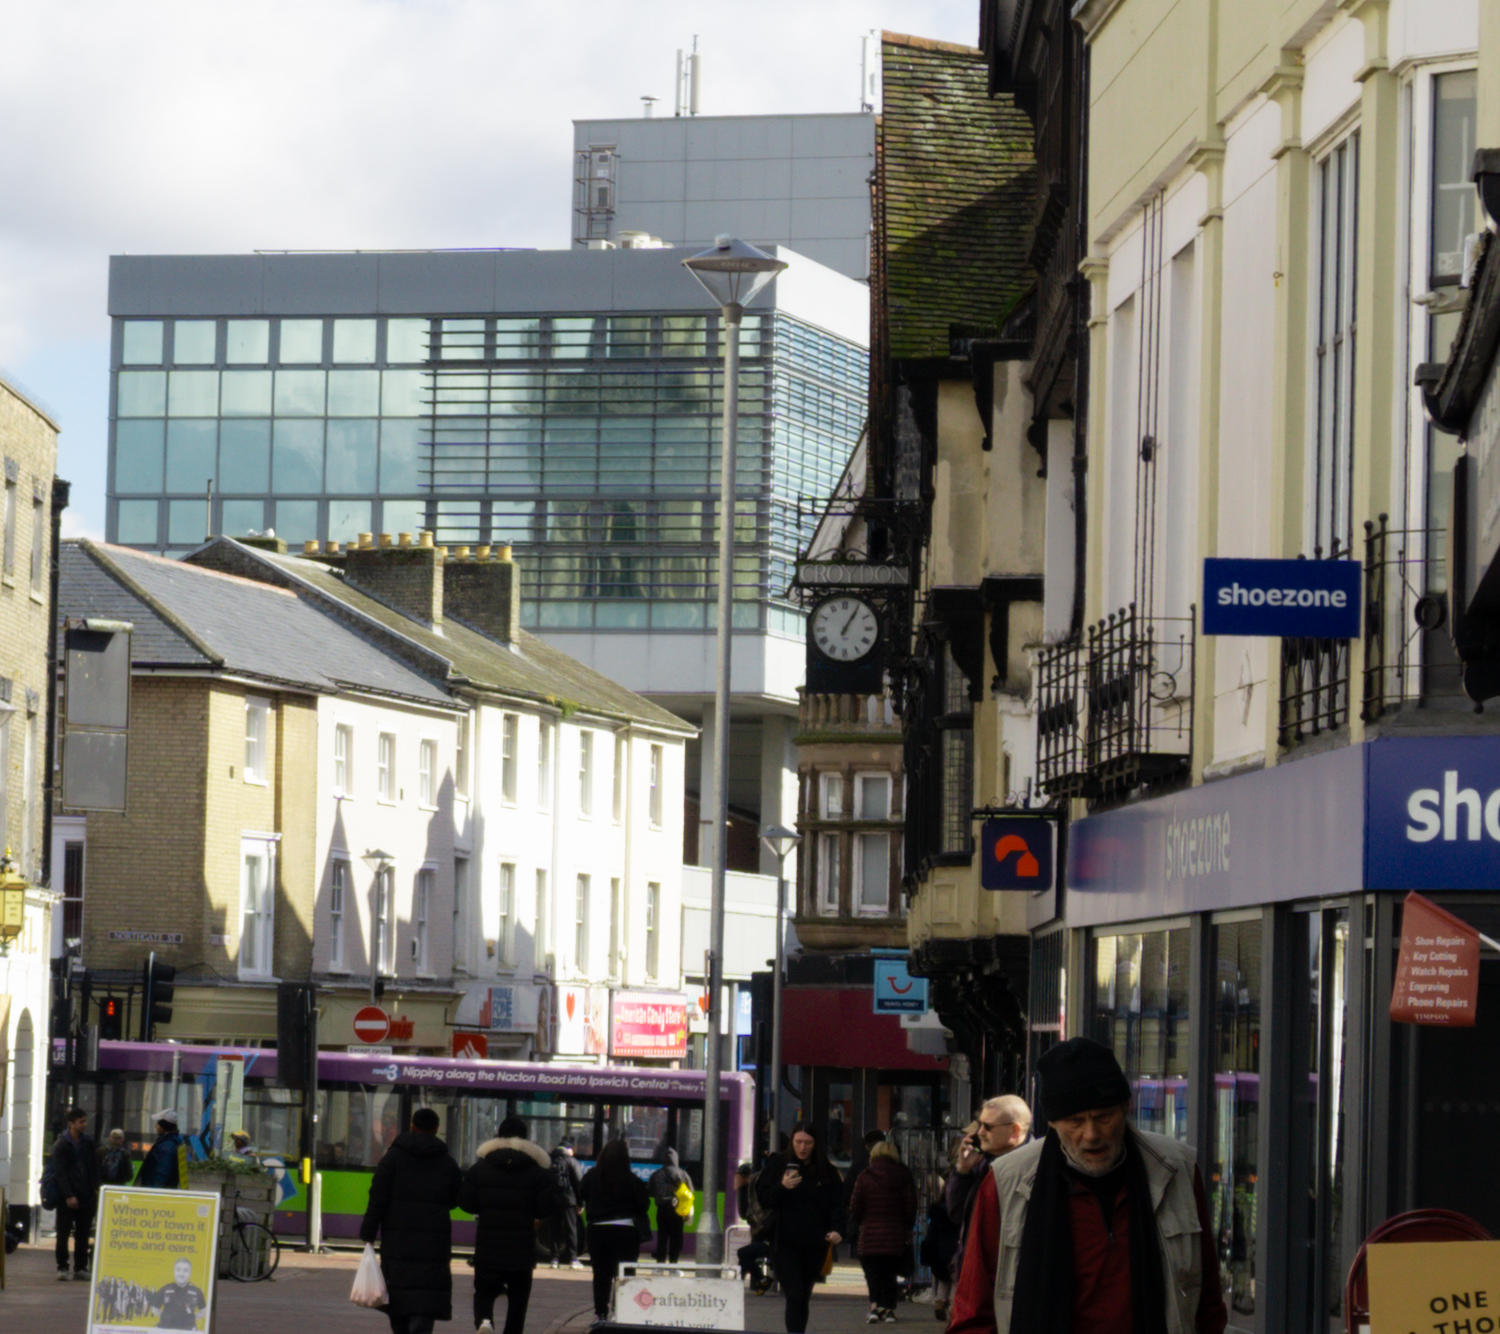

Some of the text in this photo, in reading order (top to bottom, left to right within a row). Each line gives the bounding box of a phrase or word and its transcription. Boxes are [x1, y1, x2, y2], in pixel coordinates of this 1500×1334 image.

[800, 564, 909, 584] CROYDON
[1217, 582, 1347, 610] shoezone
[1165, 804, 1231, 880] shoezone
[114, 931, 162, 942] NORTHGATE
[1415, 936, 1466, 948] Shoe Repairs
[1412, 951, 1458, 963] Key Cutting
[1411, 966, 1469, 978] Watch Repairs
[1409, 981, 1450, 994] Engraving
[1407, 996, 1469, 1009] Phone Repairs
[1414, 1013, 1450, 1021] TIMPSON
[350, 1047, 390, 1056] Except cycles
[387, 1064, 398, 1081] 3
[403, 1067, 443, 1080] Nipping
[446, 1069, 475, 1082] along
[477, 1071, 494, 1081] the
[497, 1072, 536, 1083] Nacton
[538, 1073, 567, 1084] Road
[567, 1075, 586, 1085] into
[589, 1076, 629, 1088] Ipswich
[631, 1078, 670, 1089] Central
[112, 1204, 175, 1219] When you
[112, 1216, 205, 1232] visit our town it
[110, 1228, 196, 1242] gives us extra
[109, 1239, 198, 1254] eyes and ears.
[640, 1291, 727, 1311] Craftability
[1430, 1290, 1488, 1316] ONE
